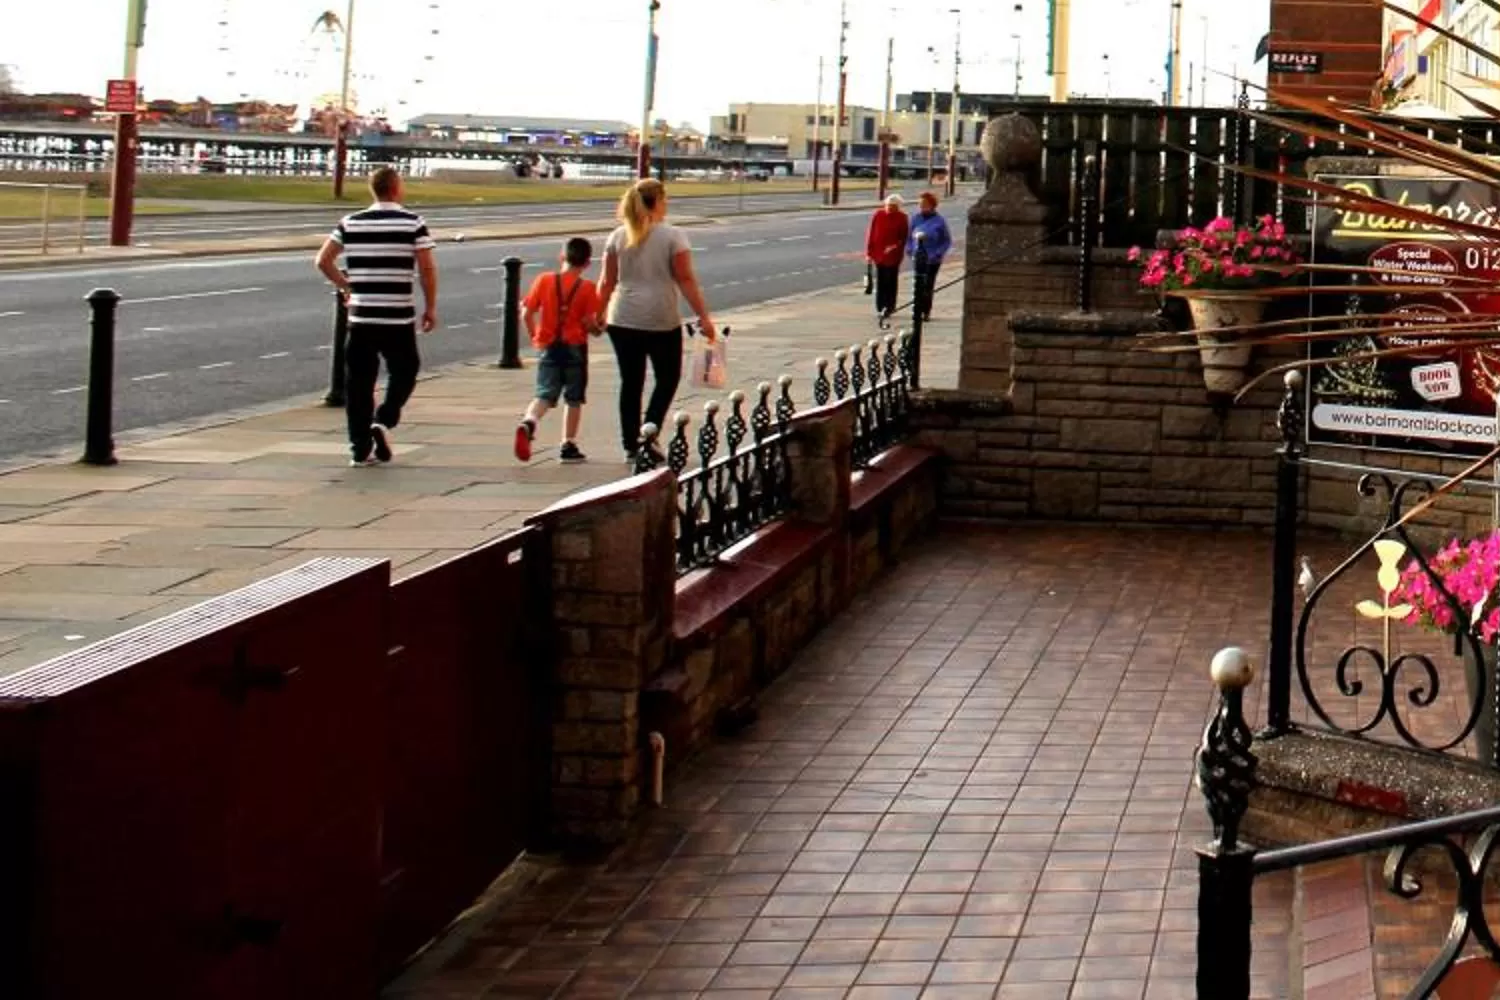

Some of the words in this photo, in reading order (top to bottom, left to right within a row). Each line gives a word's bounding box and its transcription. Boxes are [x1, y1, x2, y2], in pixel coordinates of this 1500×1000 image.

[1272, 53, 1317, 64] REFLEX
[1397, 247, 1431, 260] Special
[1419, 369, 1452, 382] BOOK
[1424, 382, 1450, 394] NOW
